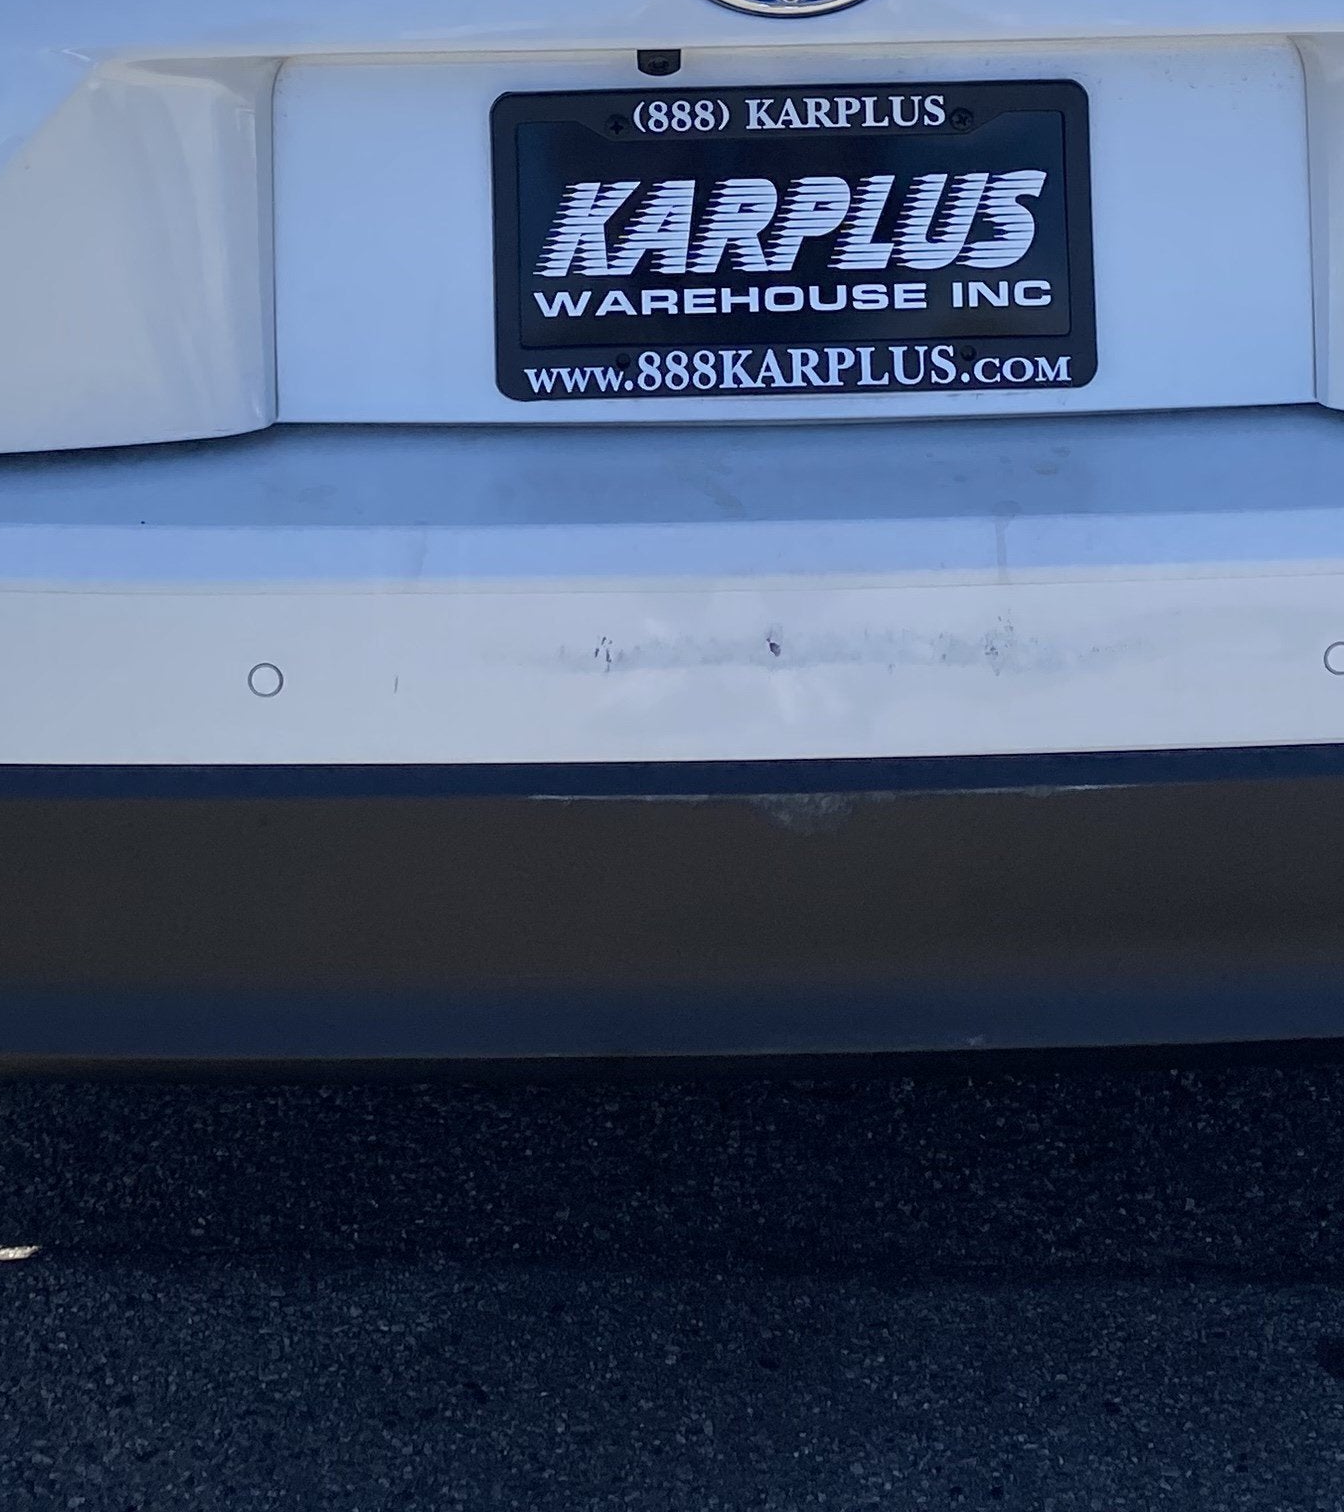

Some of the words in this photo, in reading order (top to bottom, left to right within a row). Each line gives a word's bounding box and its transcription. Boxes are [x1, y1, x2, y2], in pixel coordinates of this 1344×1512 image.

[632, 99, 730, 133] (888)
[745, 94, 946, 130] KARPLUS
[532, 169, 1048, 277] KARPLUS
[533, 283, 927, 318] WAREHOUSE
[952, 280, 1052, 308] INC
